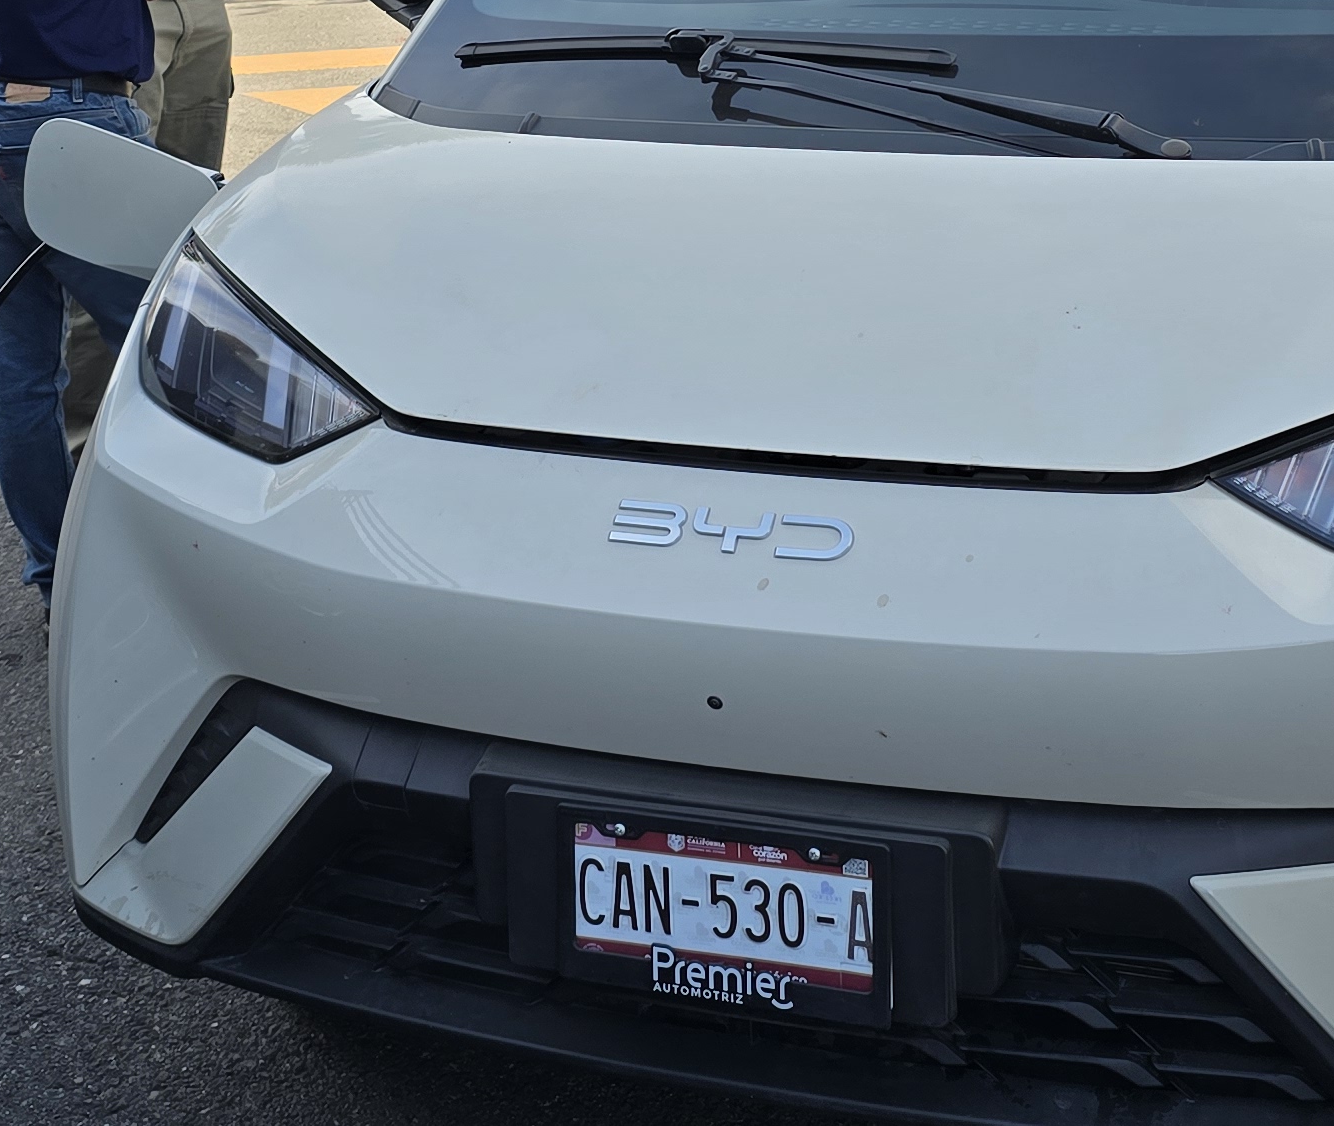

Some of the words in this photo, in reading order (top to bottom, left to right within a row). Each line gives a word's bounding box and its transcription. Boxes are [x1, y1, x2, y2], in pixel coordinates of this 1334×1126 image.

[608, 498, 855, 561] BYD
[579, 857, 873, 961] CAN-530-A
[652, 945, 791, 1002] Premier
[652, 981, 744, 1005] AUTOMOTRIZ
